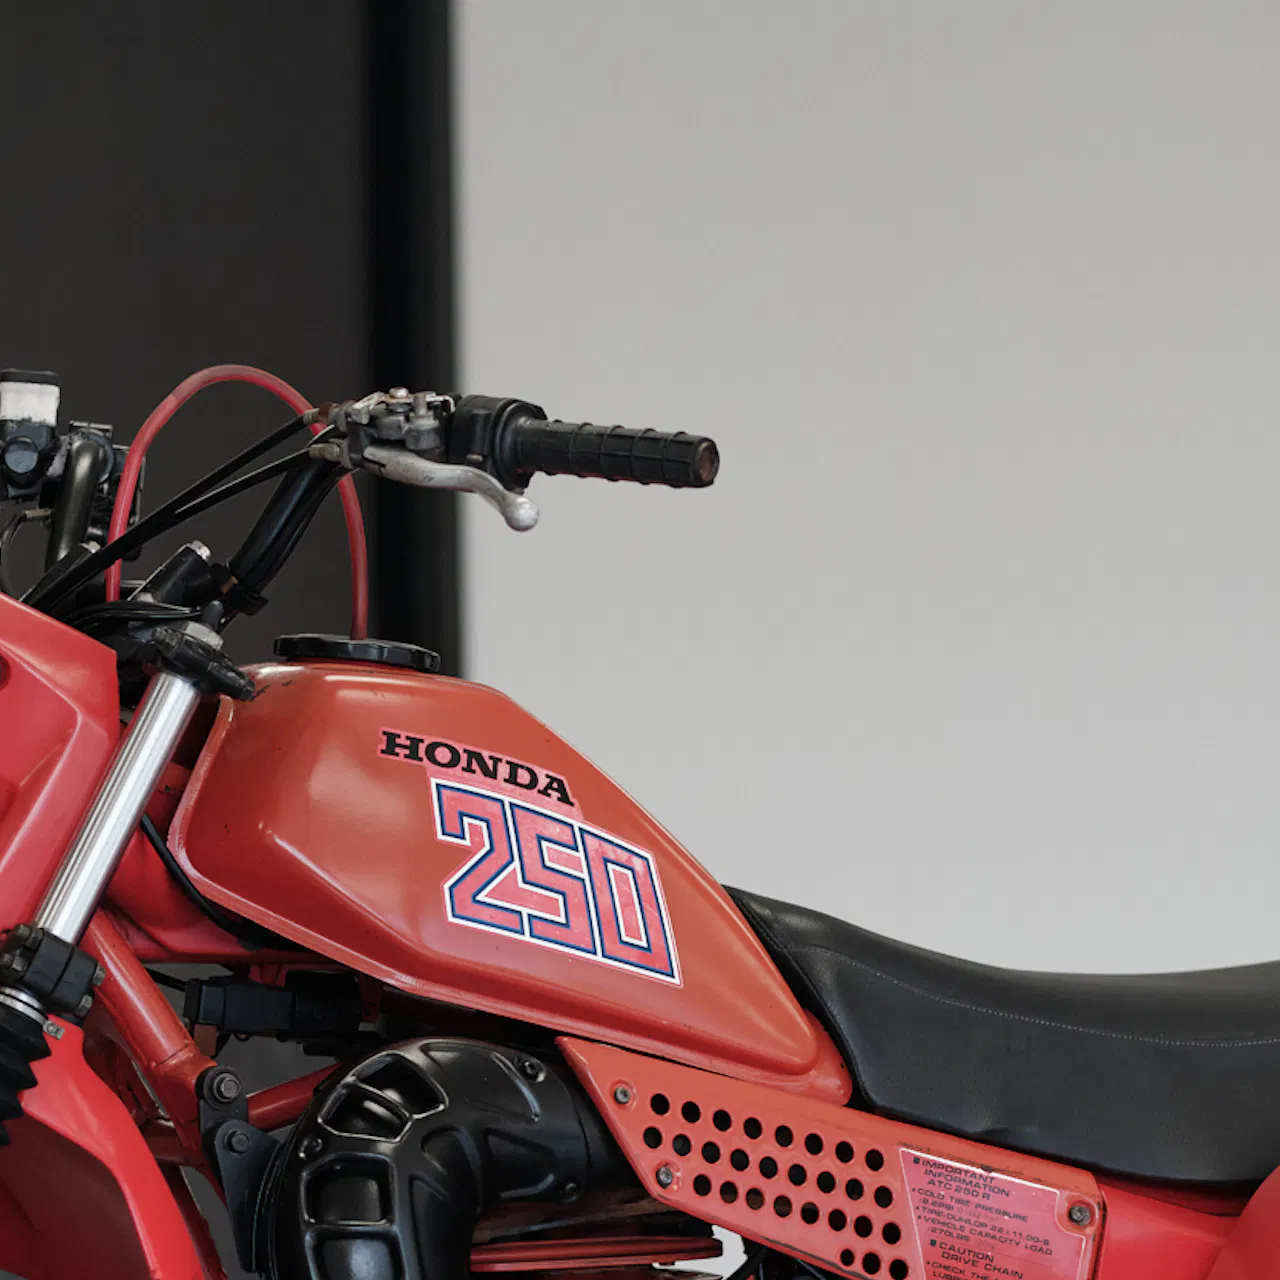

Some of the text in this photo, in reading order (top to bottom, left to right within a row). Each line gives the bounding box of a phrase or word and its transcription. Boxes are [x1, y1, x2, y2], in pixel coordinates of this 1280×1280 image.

[380, 730, 575, 807] HONDA
[430, 777, 681, 985] 250
[922, 1160, 995, 1184] IMPORTANT
[924, 1169, 1010, 1197] INFORMATION
[928, 1178, 991, 1200] ATC 250 R
[918, 1188, 945, 1200] COLD
[949, 1196, 970, 1206] TIRE
[974, 1202, 1029, 1222] PRESSURE
[923, 1216, 966, 1233] VEHICLE
[969, 1228, 1021, 1247] CAPACITY
[1024, 1243, 1053, 1256] LOAD
[939, 1241, 995, 1263] CAUTION
[941, 1251, 1024, 1279] DRIVE CHAIN
[931, 1261, 966, 1275] CHECK
